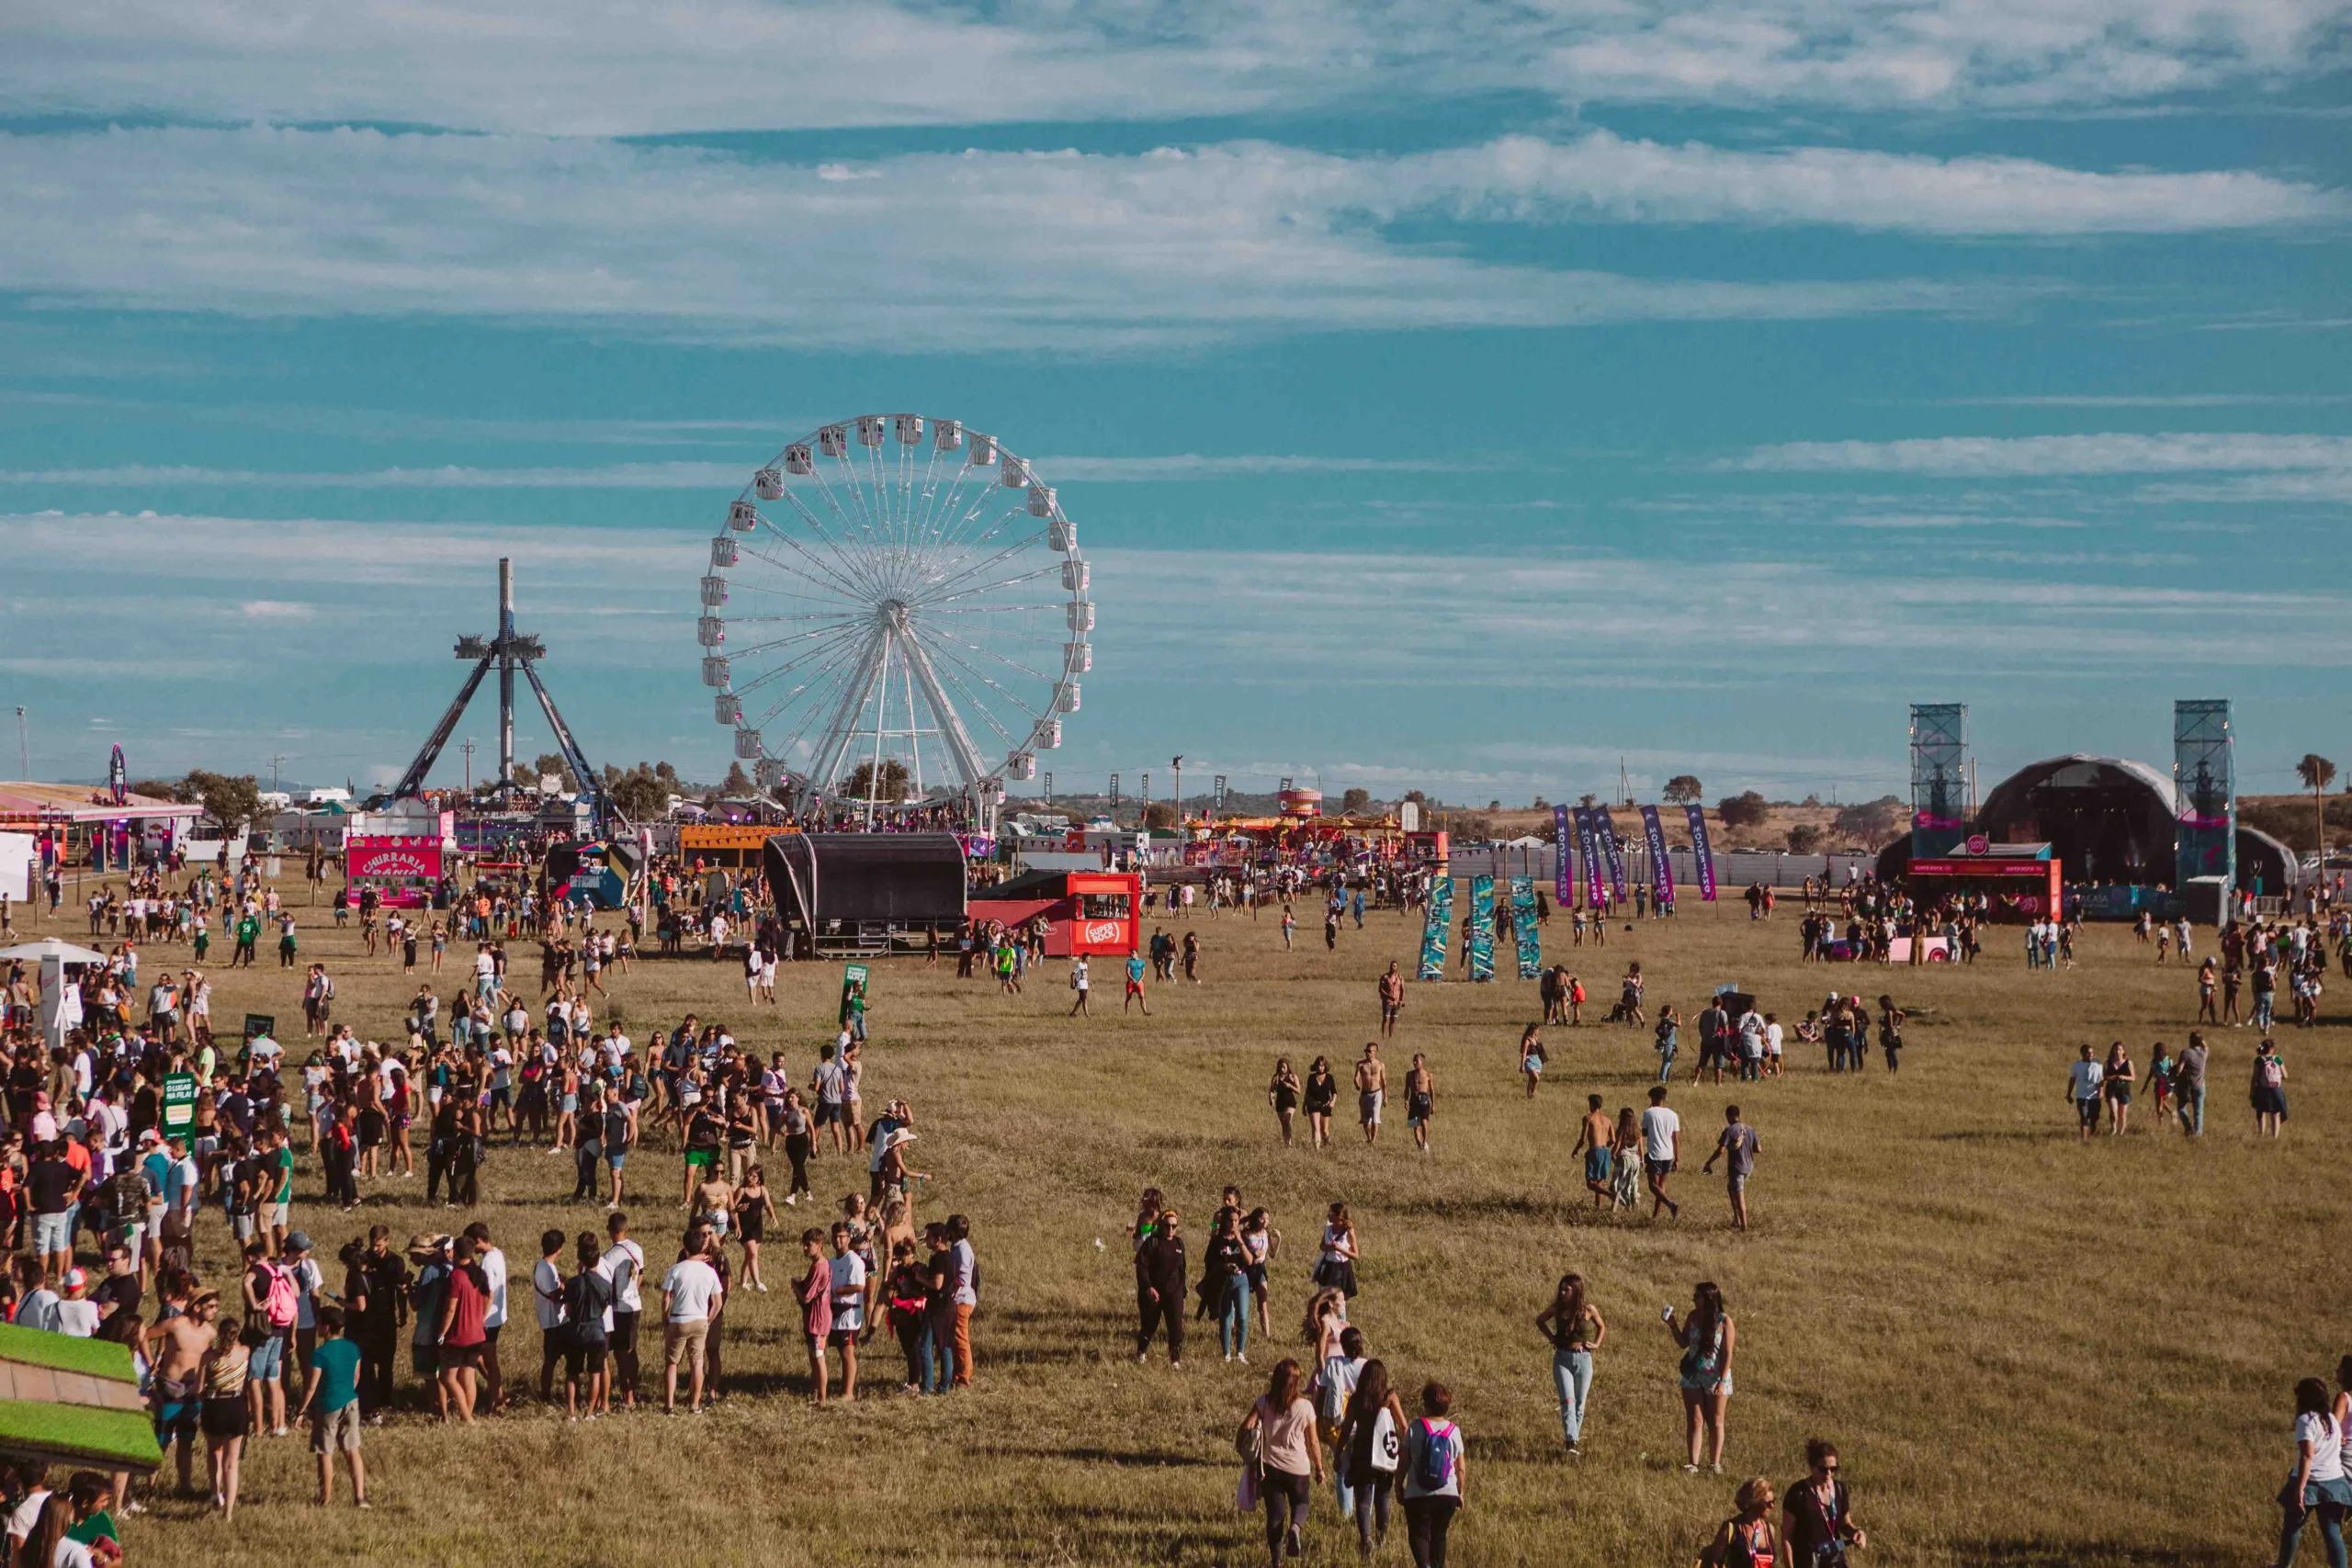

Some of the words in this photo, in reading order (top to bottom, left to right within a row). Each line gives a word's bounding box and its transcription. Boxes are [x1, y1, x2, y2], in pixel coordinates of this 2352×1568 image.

[362, 852, 425, 874] CHURRARIA
[1089, 922, 1114, 937] SUPER
[1093, 929, 1115, 943] BOCK
[172, 1084, 192, 1092] LUGAR
